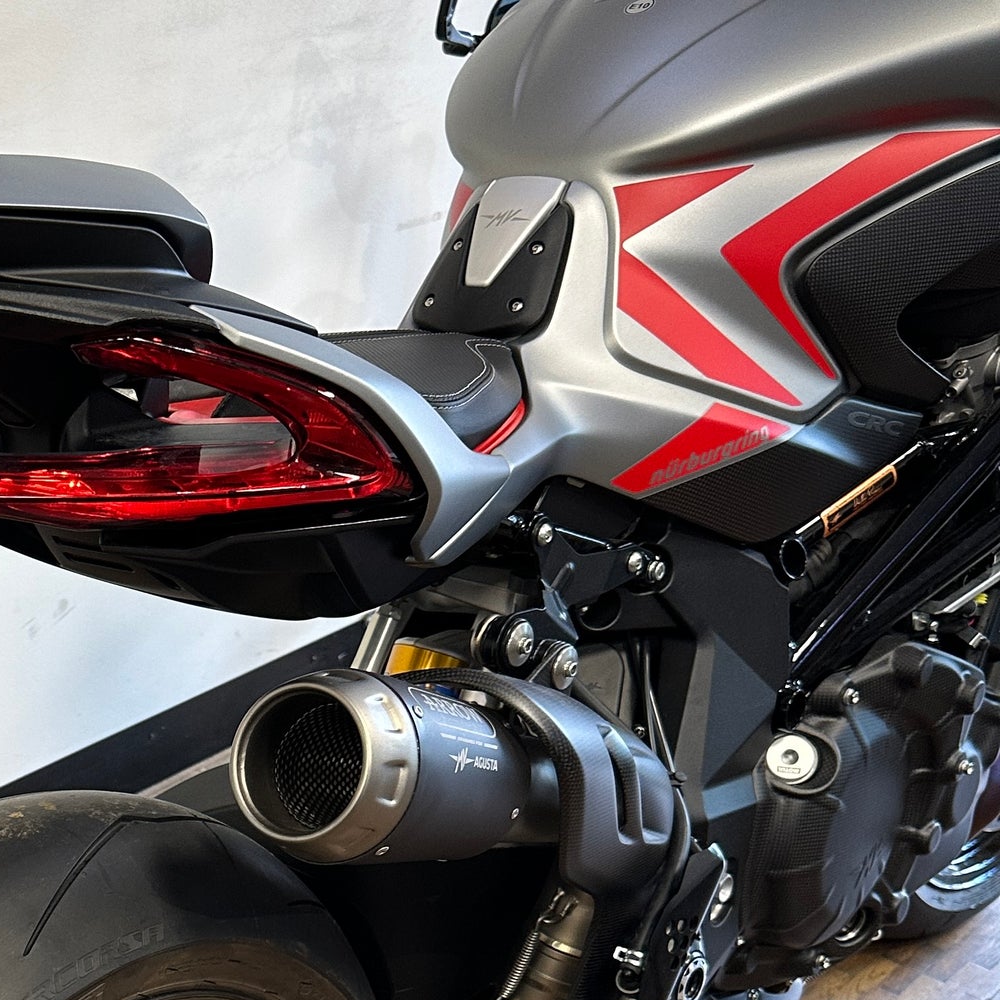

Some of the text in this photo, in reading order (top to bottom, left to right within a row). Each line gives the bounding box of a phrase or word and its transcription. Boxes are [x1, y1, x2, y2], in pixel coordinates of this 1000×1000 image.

[629, 2, 651, 10] E10
[847, 411, 904, 437] CRC
[648, 425, 771, 485] nürburgring
[473, 756, 498, 772] AGUSTA
